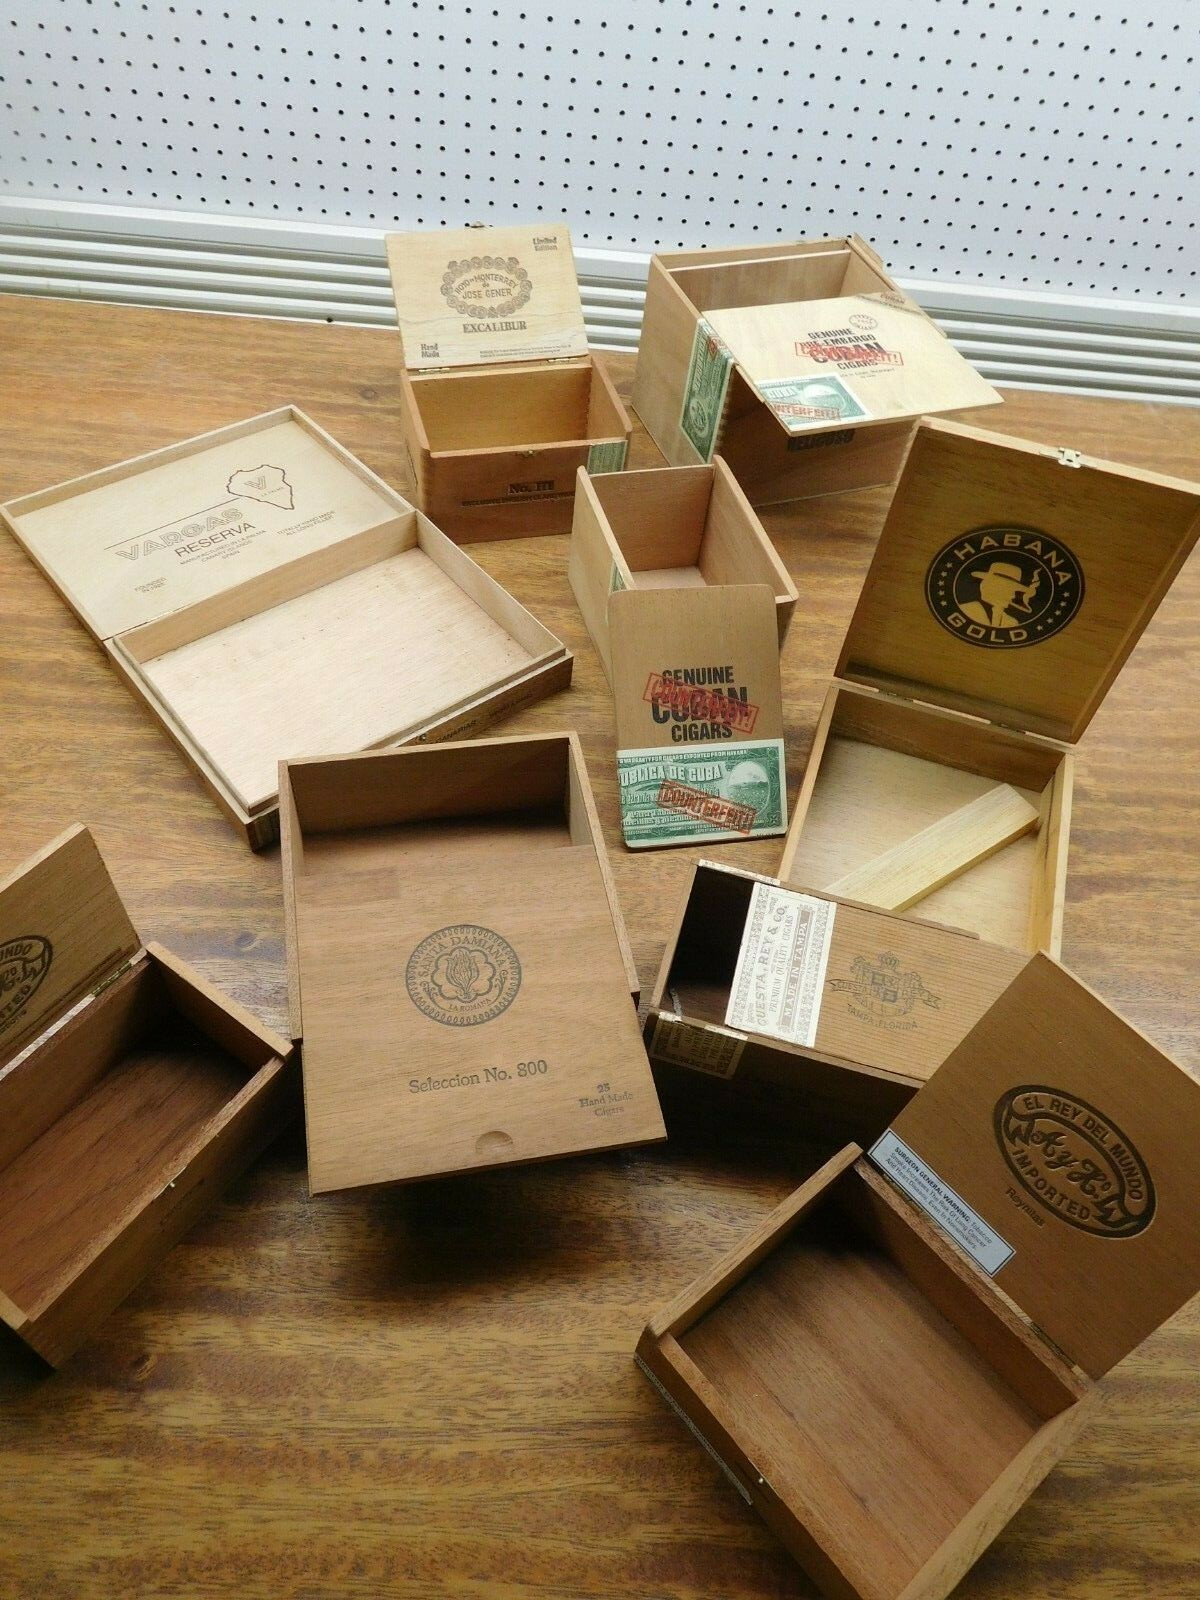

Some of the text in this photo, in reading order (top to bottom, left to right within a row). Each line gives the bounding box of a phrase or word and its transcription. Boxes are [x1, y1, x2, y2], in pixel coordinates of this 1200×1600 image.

[462, 288, 512, 300] JOSE GENER
[474, 273, 519, 289] MONTERREY
[462, 321, 528, 333] EXCALIBUR
[808, 328, 854, 340] GENUINE
[837, 359, 879, 371] CIGARS
[115, 507, 243, 561] VARGAS
[174, 522, 256, 558] RESERVA
[954, 533, 1072, 586] HABANA
[947, 612, 1028, 643] GOLD
[662, 666, 735, 686] GENUINE
[651, 686, 748, 724] CUBAN
[671, 722, 733, 742] CIGARS
[669, 765, 686, 781] DE
[688, 763, 722, 782] CUBA
[782, 914, 794, 941] CIGARS
[418, 936, 507, 977] SANTA DAMIANA
[756, 936, 775, 965] REY
[775, 945, 788, 976] QUALITY
[784, 922, 809, 1016] MADE IN TAMPA
[449, 998, 491, 1012] LA ROMANA
[769, 978, 782, 1013] PREMIUM
[409, 1059, 548, 1093] Seleccion No. 800
[597, 1083, 610, 1093] 25
[579, 1095, 606, 1107] Hand
[1023, 1096, 1143, 1201] EL REY DEL MUNDO
[886, 1157, 896, 1169] And
[928, 1199, 941, 1215] Even
[889, 1152, 907, 1170] Smoke
[906, 1166, 930, 1194] Increases
[929, 1190, 940, 1202] The
[939, 1200, 950, 1213] Risk
[955, 1215, 968, 1232] Lung
[968, 1228, 987, 1249] Cancer
[894, 1146, 993, 1245] SURGEON GENERAL WARNING: Tobacco
[1011, 1149, 1091, 1221] IMPORTED
